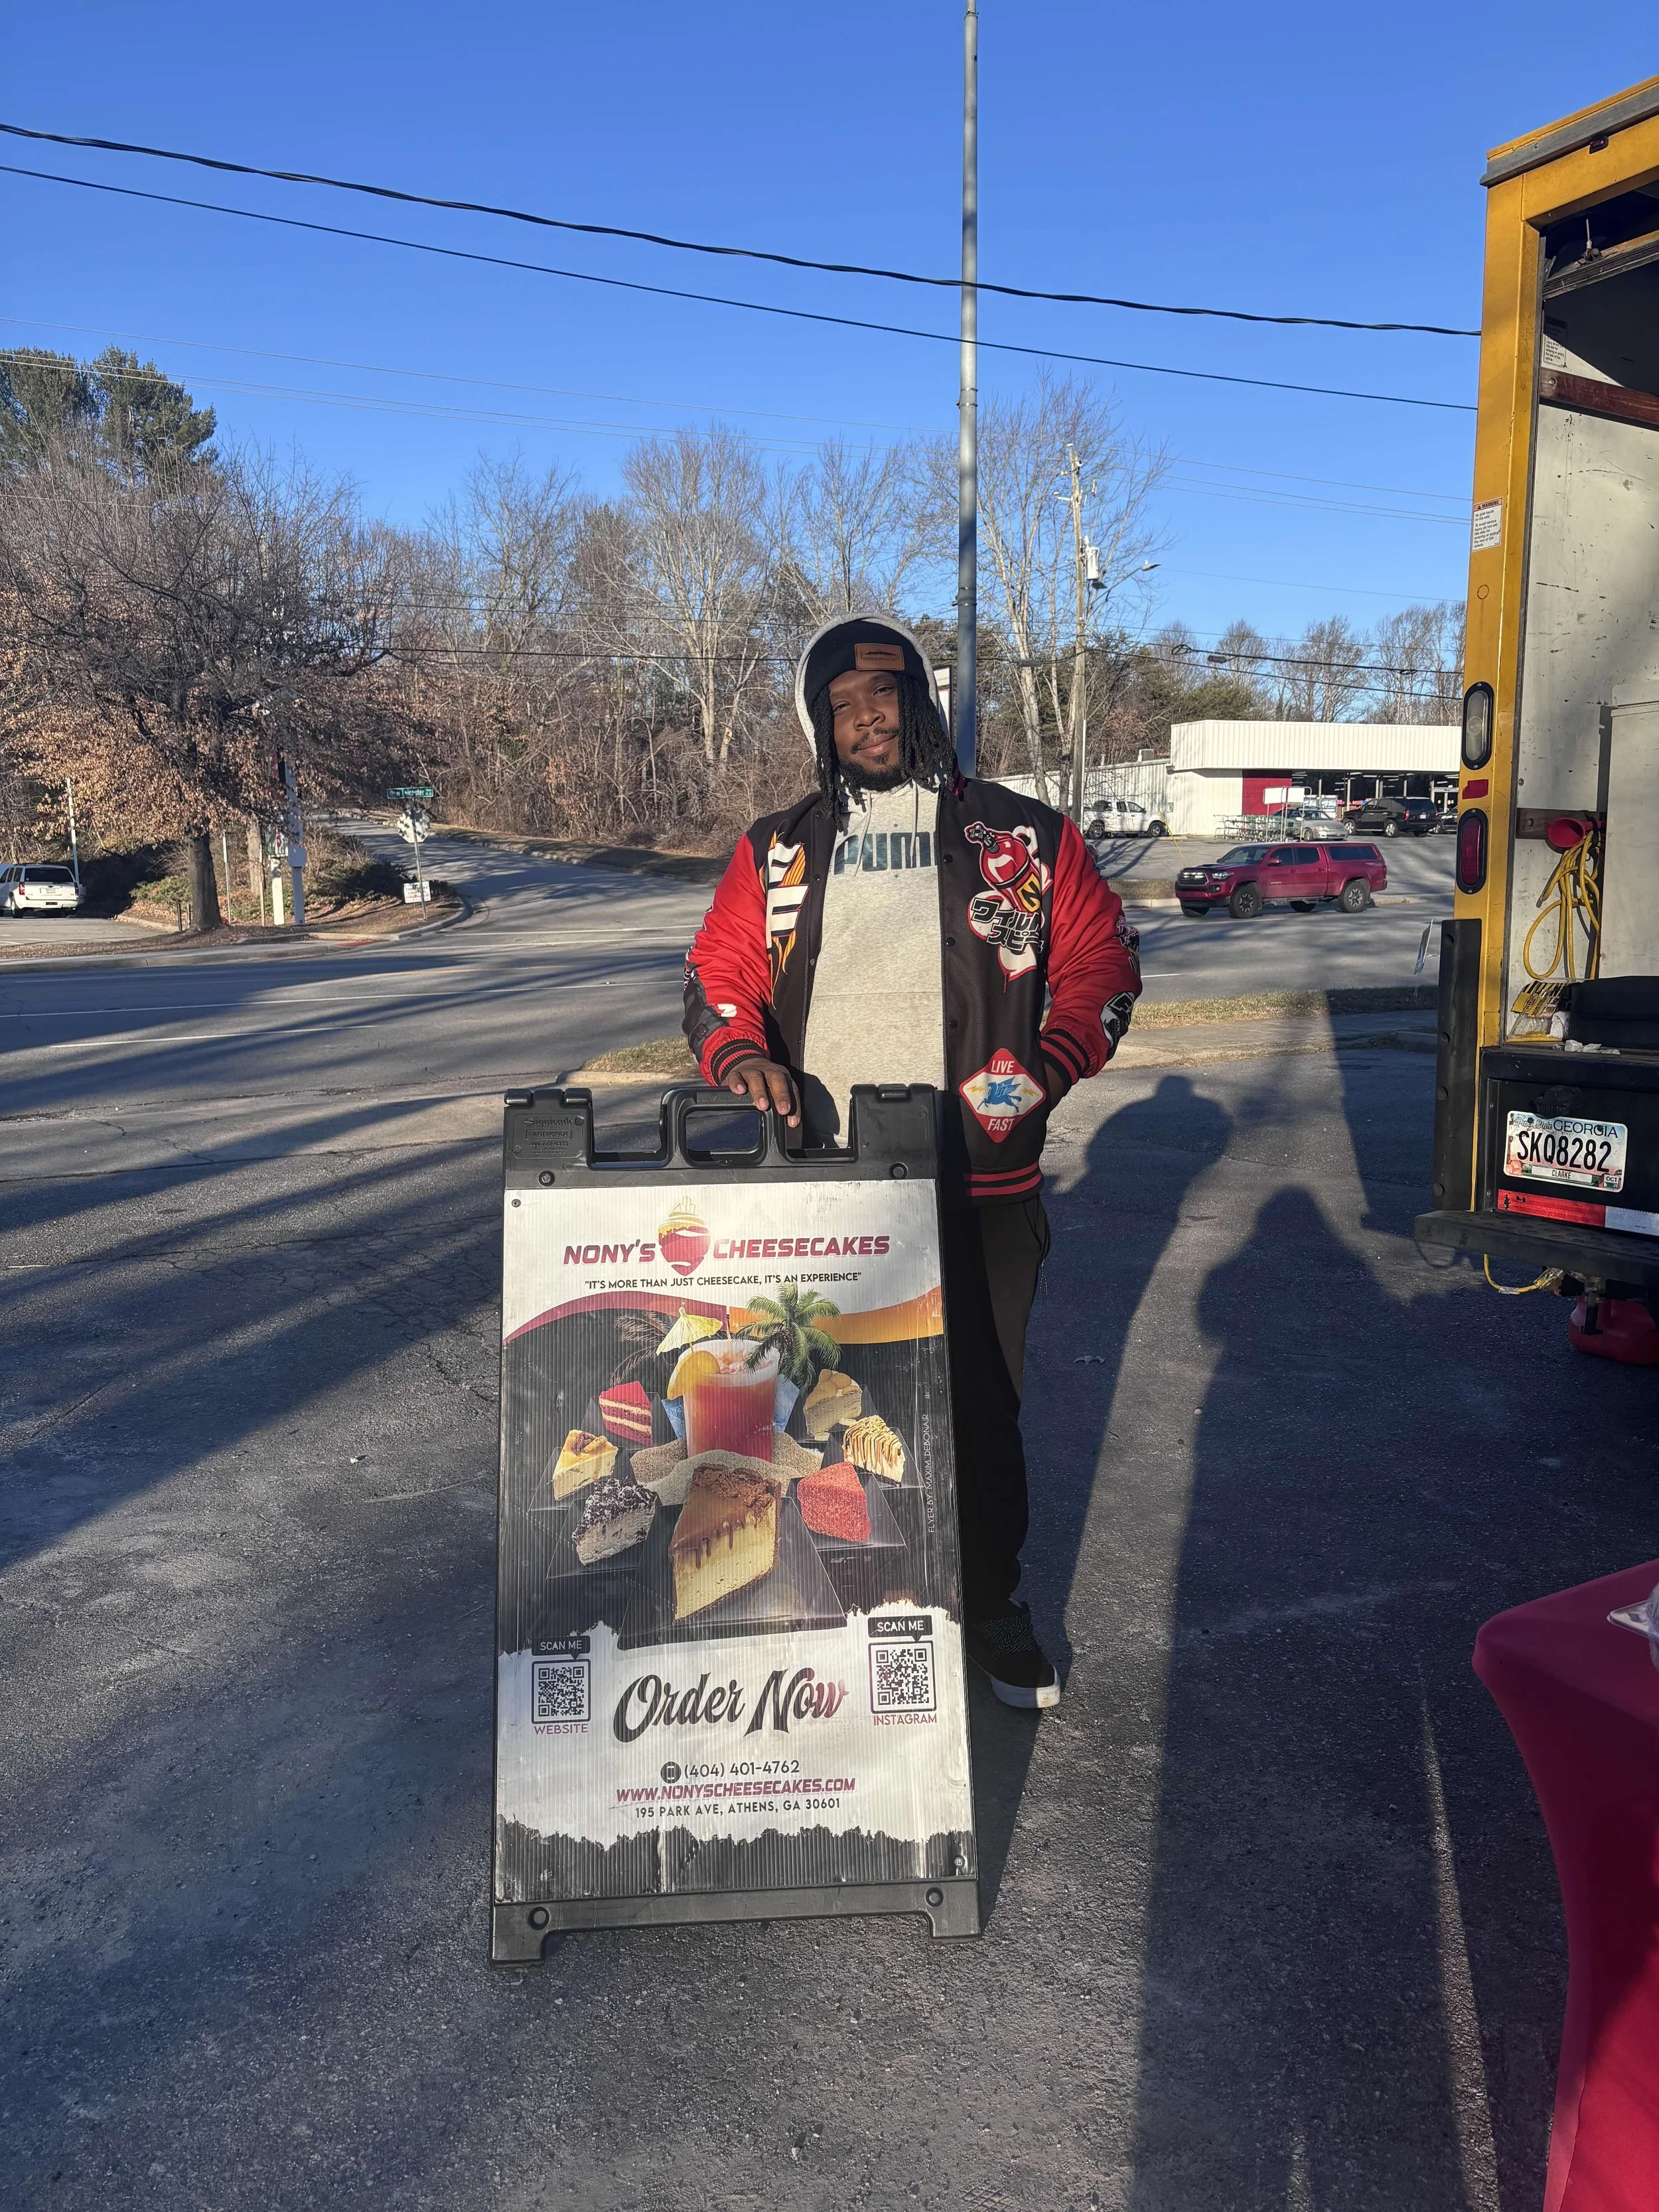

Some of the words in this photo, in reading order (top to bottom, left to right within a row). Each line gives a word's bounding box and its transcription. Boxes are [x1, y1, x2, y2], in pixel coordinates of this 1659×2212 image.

[833, 832, 938, 875] PUM
[991, 1060, 1015, 1073] LIVE
[987, 1118, 1015, 1131] FAST
[1553, 1120, 1618, 1138] GEORGIA
[1517, 1130, 1612, 1173] SKQ8282
[1551, 1169, 1571, 1179] CLARKE
[563, 1239, 656, 1265] NONY'S
[713, 1235, 890, 1259] CHEESECAKES
[609, 1280, 638, 1289] MORE
[640, 1278, 668, 1288] THAN
[670, 1278, 694, 1286] JUST
[697, 1275, 762, 1286] CHEESECAKE,
[784, 1274, 798, 1283] AN
[801, 1272, 862, 1282] EXPERIENCE"
[922, 1414, 930, 1456] DEBONAIR
[877, 1621, 905, 1632] SCAN
[908, 1620, 924, 1631] ME
[540, 1641, 565, 1651] SCAN
[568, 1640, 582, 1649] ME
[613, 1672, 745, 1743] Order
[743, 1667, 849, 1737] Now
[873, 1713, 937, 1726] INSTAGRAM
[534, 1724, 588, 1735] WEBSITE
[684, 1763, 725, 1779] (404)
[730, 1760, 800, 1775] 401-4762
[616, 1778, 855, 1802] WWW.NONYSCHEESECAKES.COM
[636, 1807, 654, 1818] 195
[660, 1805, 690, 1816] PARK
[695, 1804, 723, 1816] AVE,
[728, 1801, 778, 1813] ATHENS,
[783, 1800, 800, 1810] GA
[806, 1798, 839, 1809] 30601
